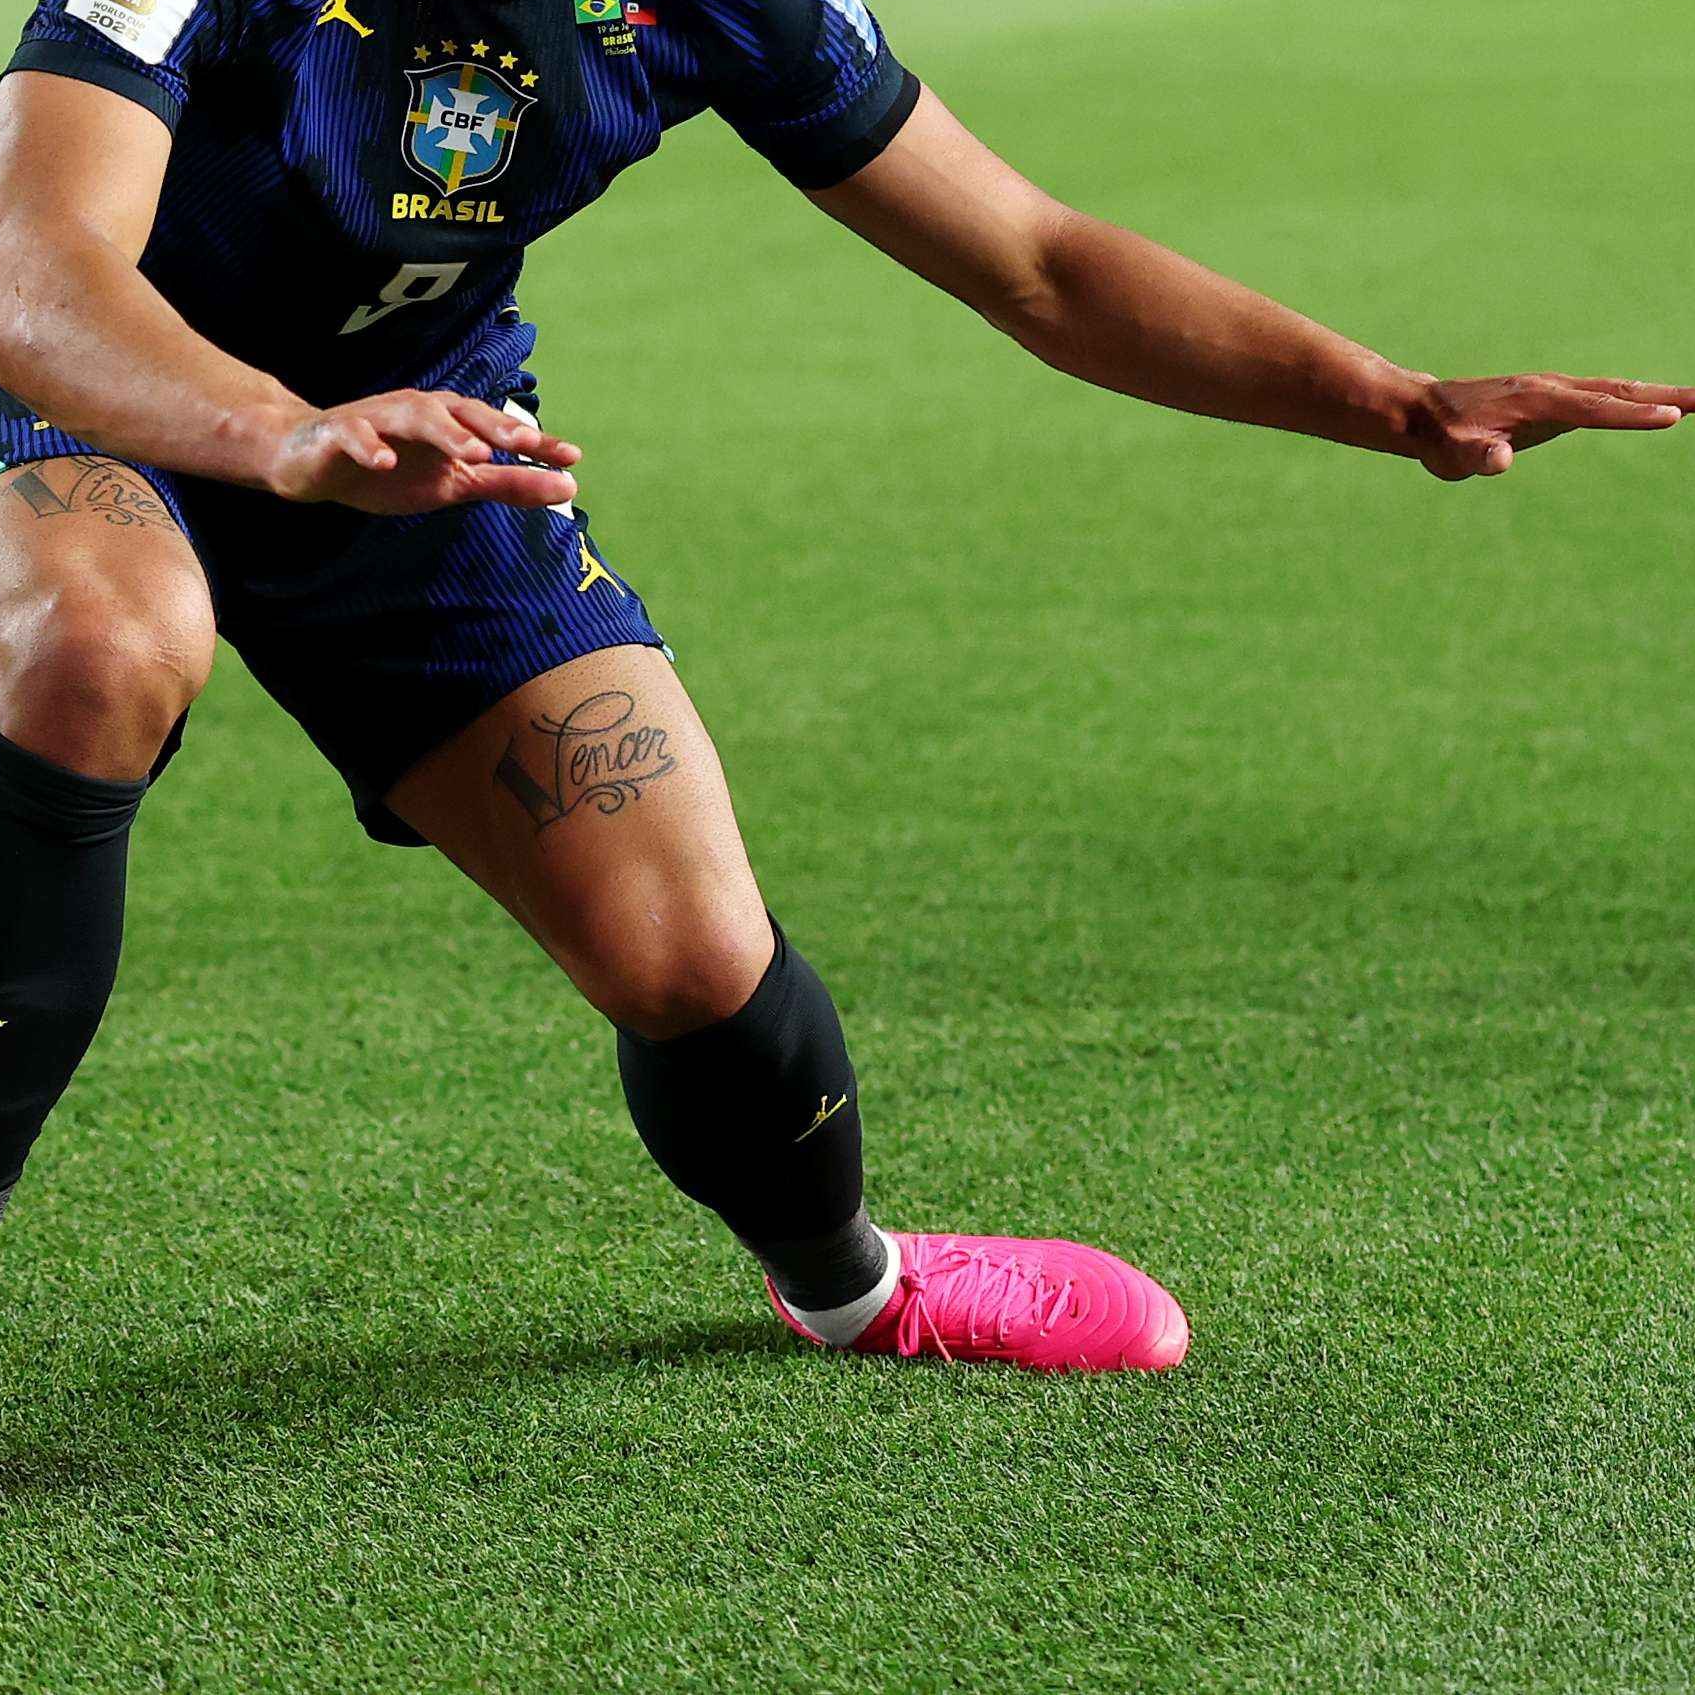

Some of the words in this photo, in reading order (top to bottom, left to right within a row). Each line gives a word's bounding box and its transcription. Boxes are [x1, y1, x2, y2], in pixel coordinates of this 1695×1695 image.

[93, 1, 126, 20] WORLD
[440, 110, 485, 131] CBF
[391, 193, 505, 223] BRASIL
[337, 261, 470, 335] 9
